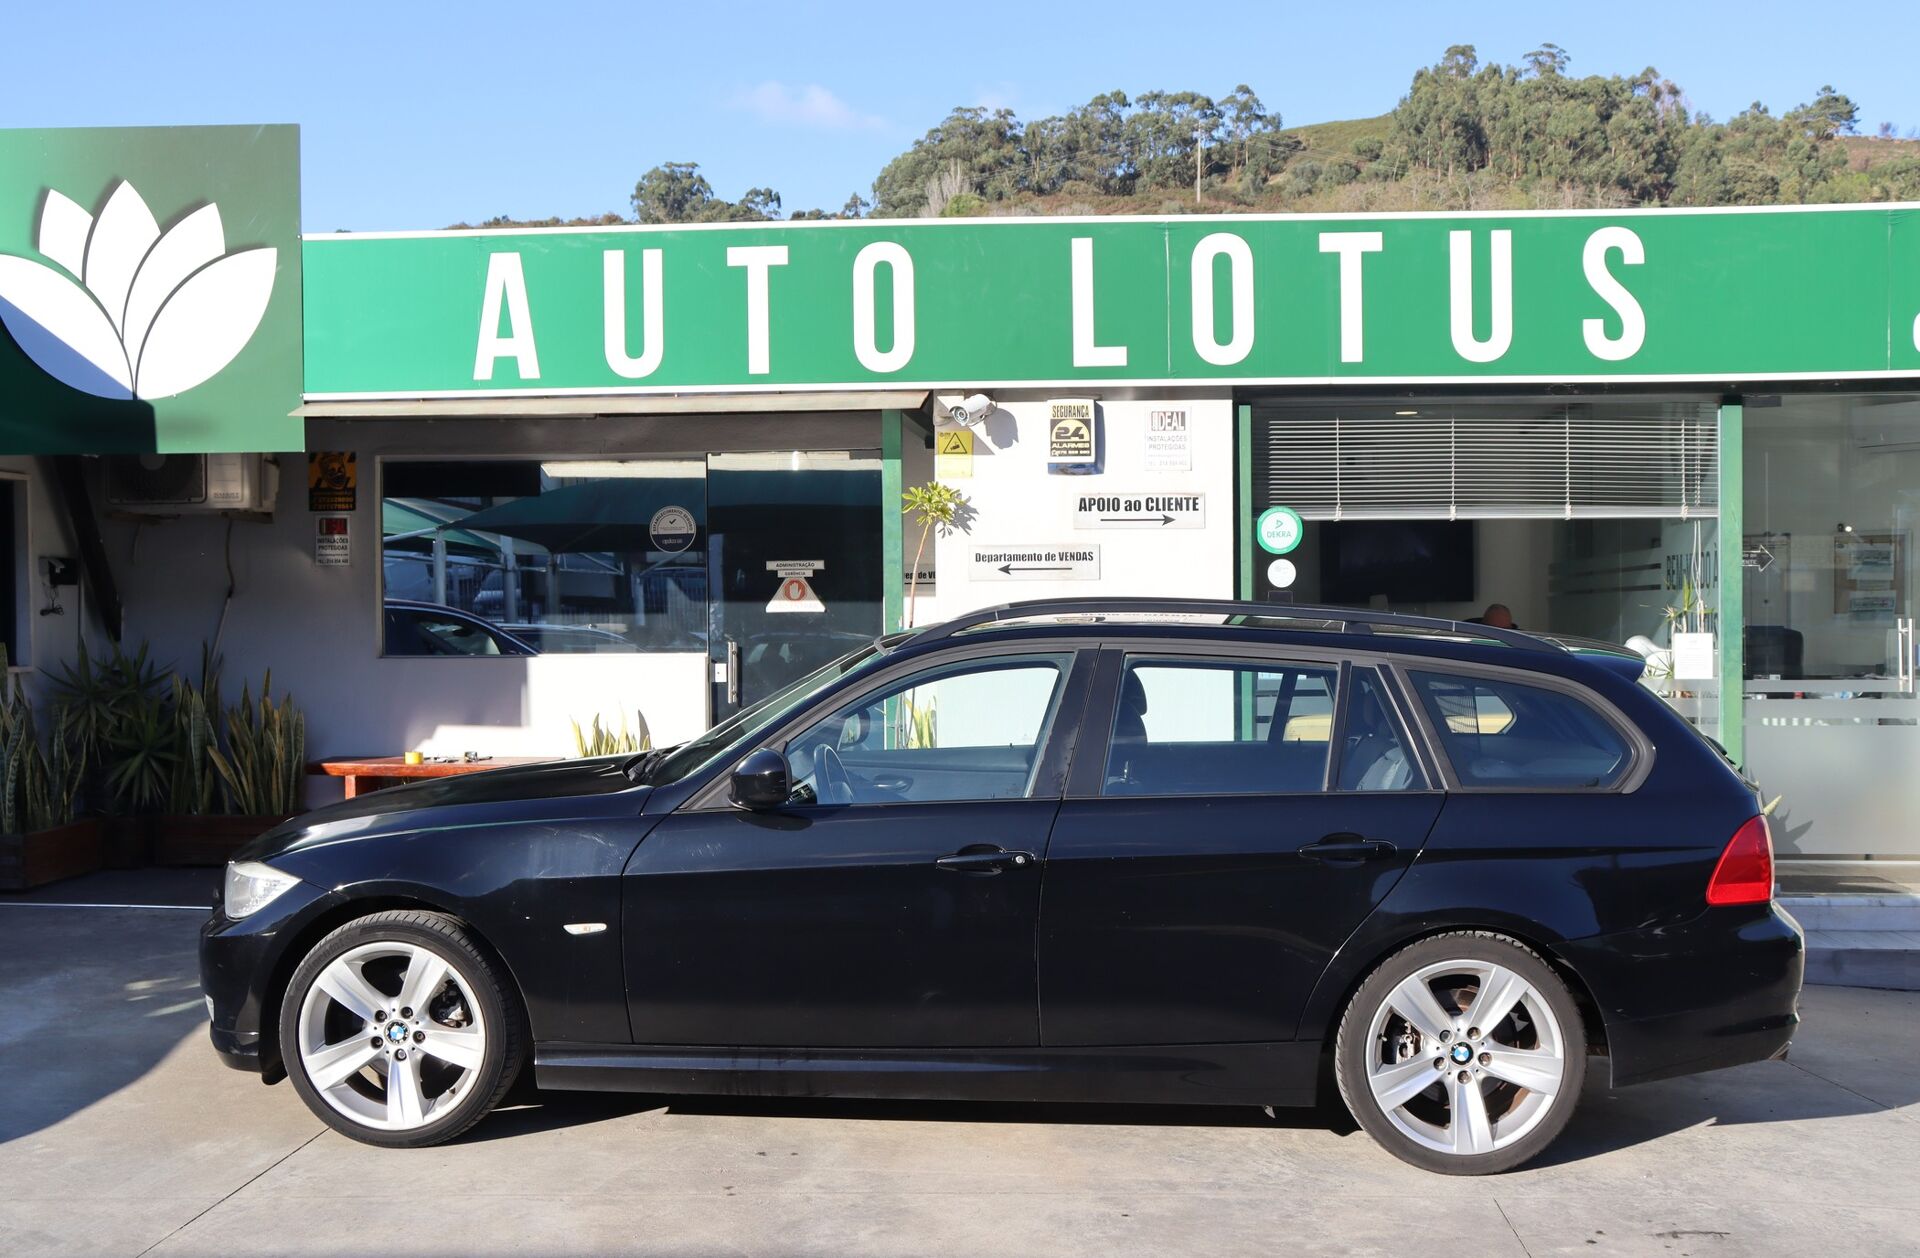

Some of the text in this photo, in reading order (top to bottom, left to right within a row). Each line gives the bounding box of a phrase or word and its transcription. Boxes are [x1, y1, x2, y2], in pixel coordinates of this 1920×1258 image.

[473, 226, 1647, 381] AUTO LOTUS
[1055, 426, 1085, 440] 24
[1078, 497, 1199, 512] APOIO ao CLIENTE
[1266, 530, 1292, 539] DEKRA
[975, 551, 1094, 563] Departamento de VENDAS
[917, 571, 927, 579] de
